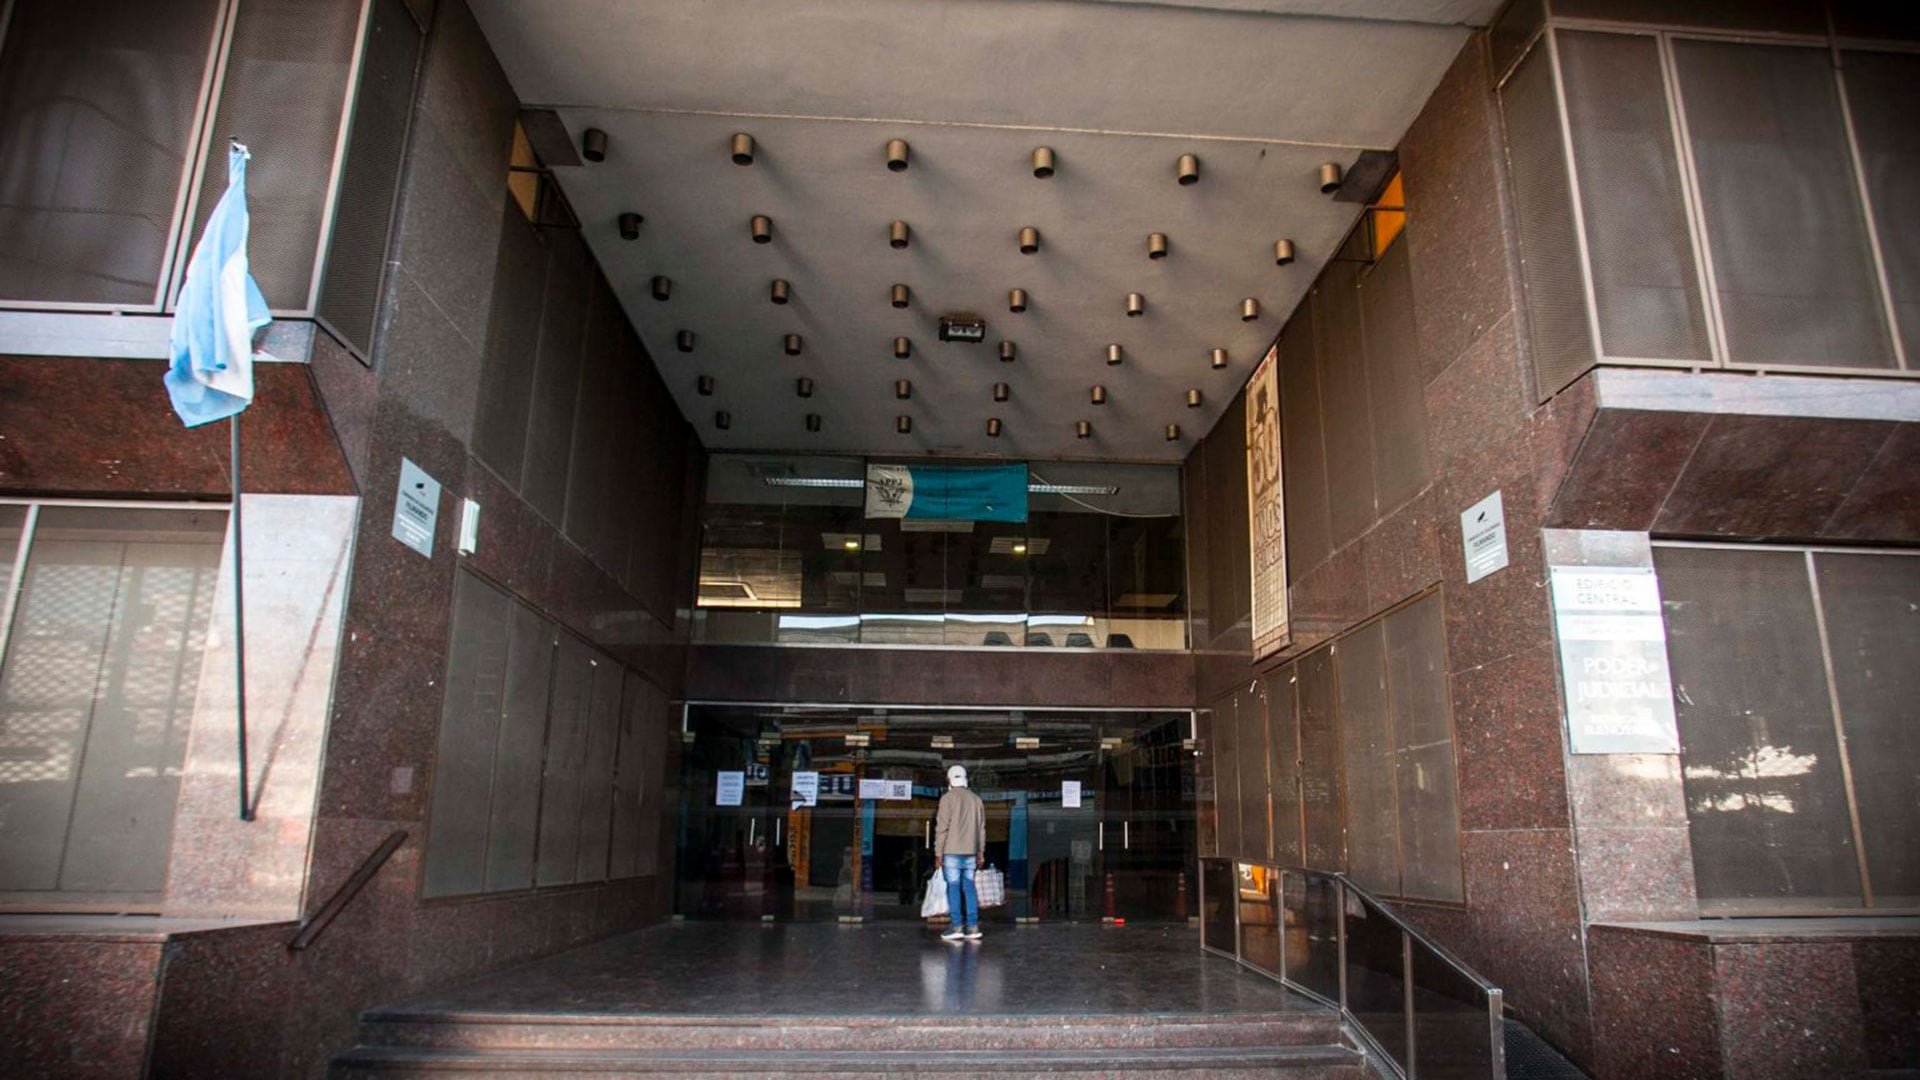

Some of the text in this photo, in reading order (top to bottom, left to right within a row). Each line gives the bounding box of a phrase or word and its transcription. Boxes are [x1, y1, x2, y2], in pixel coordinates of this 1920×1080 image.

[1576, 578, 1632, 590] EDIFICIO
[1577, 592, 1639, 605] CENTRAL
[1583, 657, 1648, 674] PODER
[1578, 681, 1664, 702] JUDICIAL
